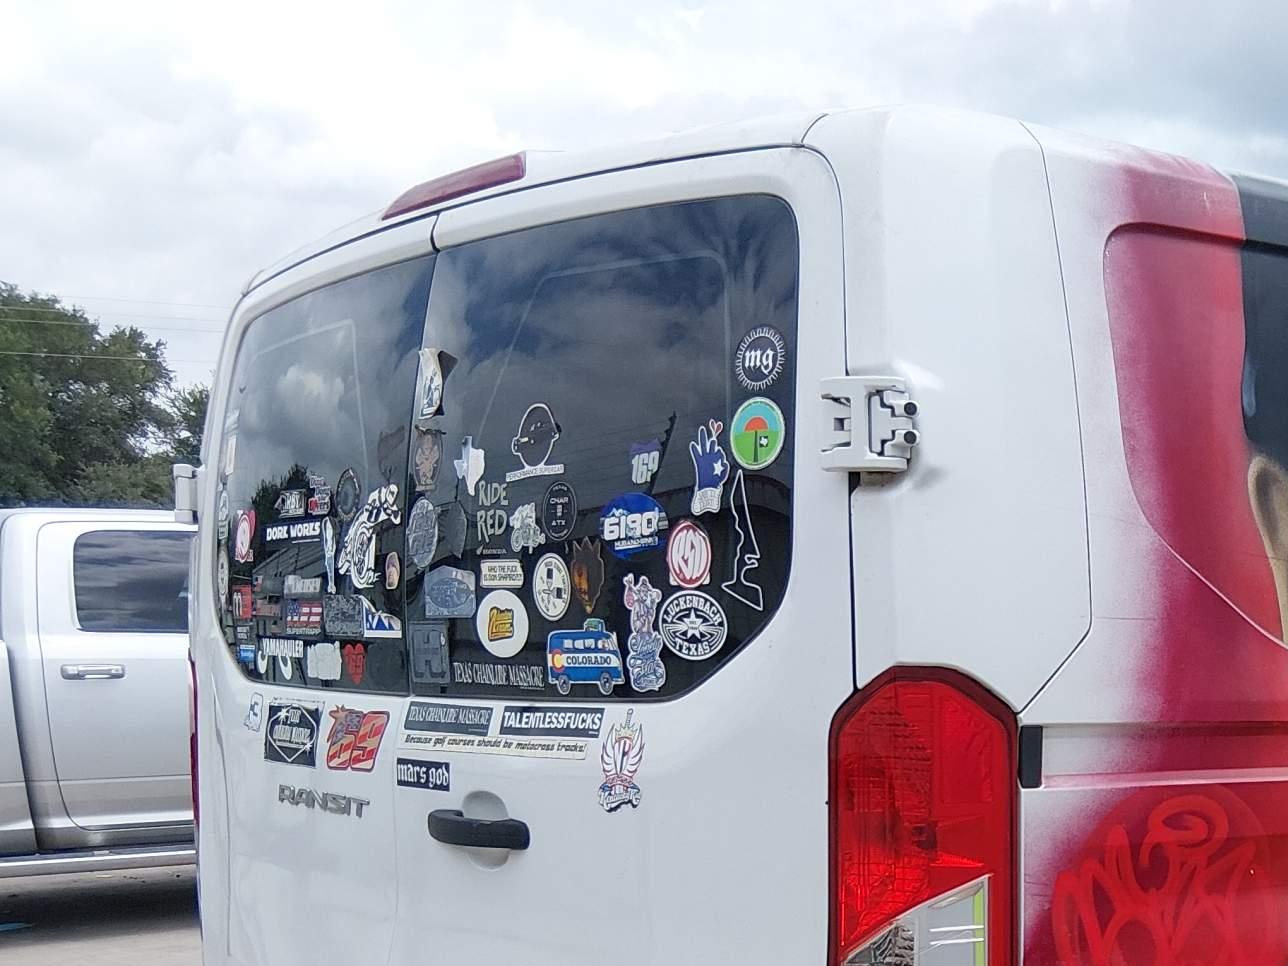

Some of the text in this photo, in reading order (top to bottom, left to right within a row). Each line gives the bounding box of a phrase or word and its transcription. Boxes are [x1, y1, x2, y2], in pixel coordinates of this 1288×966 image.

[744, 346, 776, 376] mg
[631, 450, 660, 485] 169
[478, 480, 509, 507] RIDE
[266, 522, 321, 541] DORK WORKS
[476, 509, 508, 543] RED
[663, 595, 722, 626] LUCKENBACH
[675, 637, 711, 656] TEXAS
[566, 655, 612, 666] COLORADO
[452, 661, 473, 683] TEXAS
[509, 664, 545, 687] MASSACRE
[408, 705, 427, 722] TEXAS
[503, 711, 602, 730] TALENTLESSFUCKS
[405, 733, 433, 744] Because
[433, 736, 448, 747] golf
[447, 737, 475, 747] courses
[476, 737, 503, 748] should
[502, 740, 514, 749] be
[514, 741, 555, 752] motocross
[397, 763, 427, 784] mars
